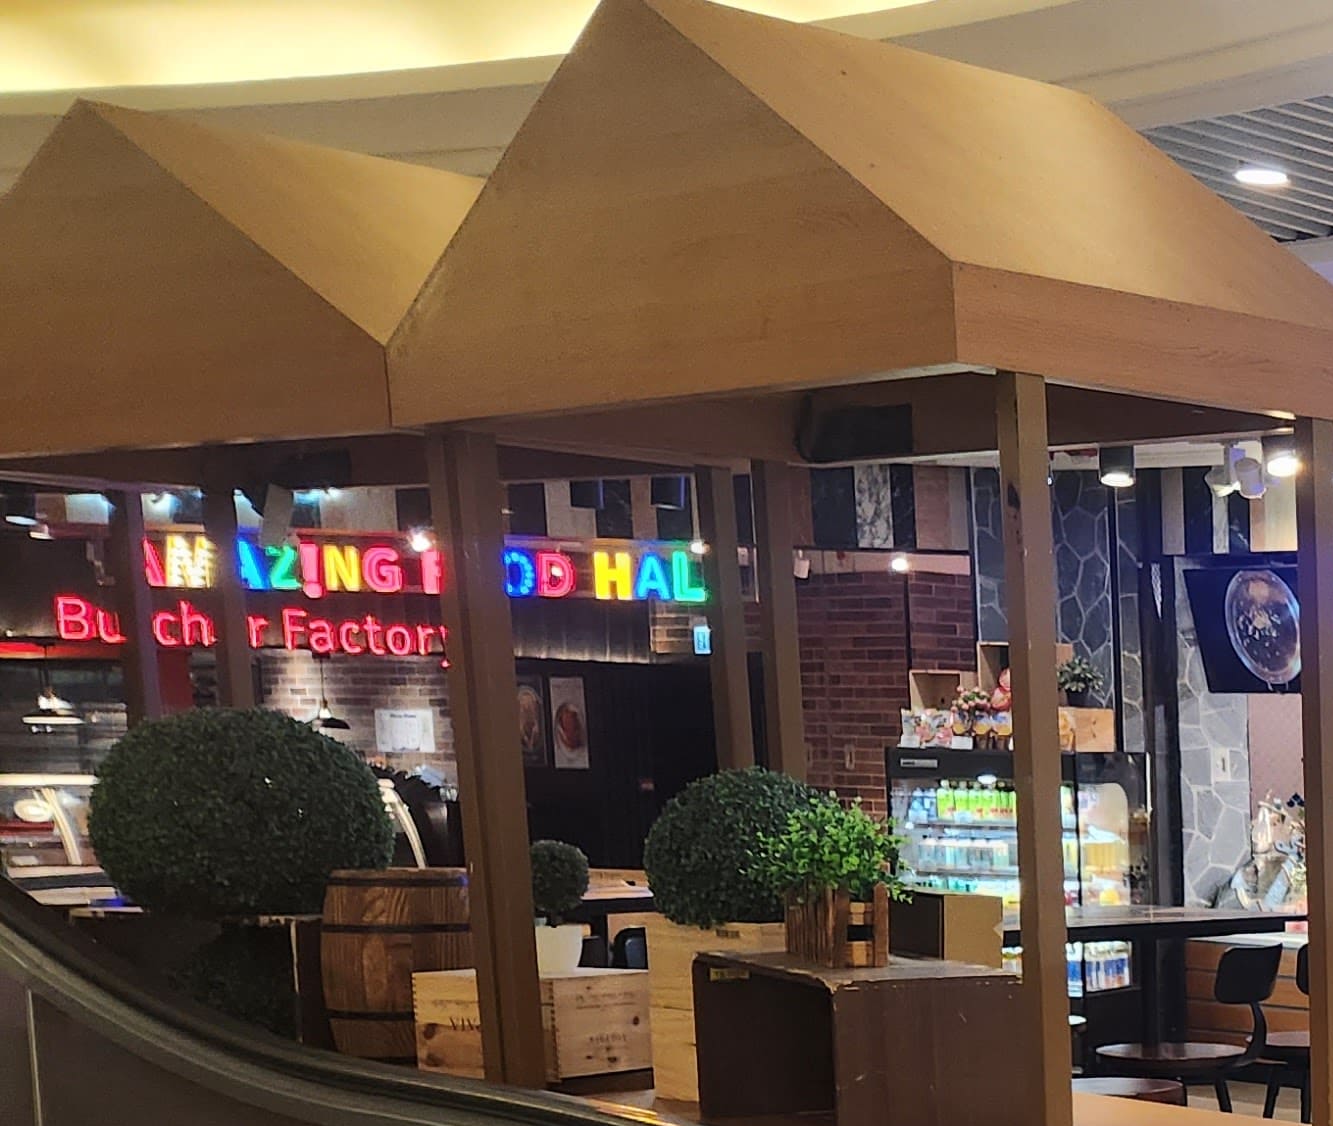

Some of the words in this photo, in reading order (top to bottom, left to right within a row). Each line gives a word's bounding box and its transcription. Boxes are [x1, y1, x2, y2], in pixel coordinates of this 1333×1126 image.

[421, 549, 577, 598] FOD
[593, 550, 709, 602] HAL
[55, 596, 269, 649] Buchr
